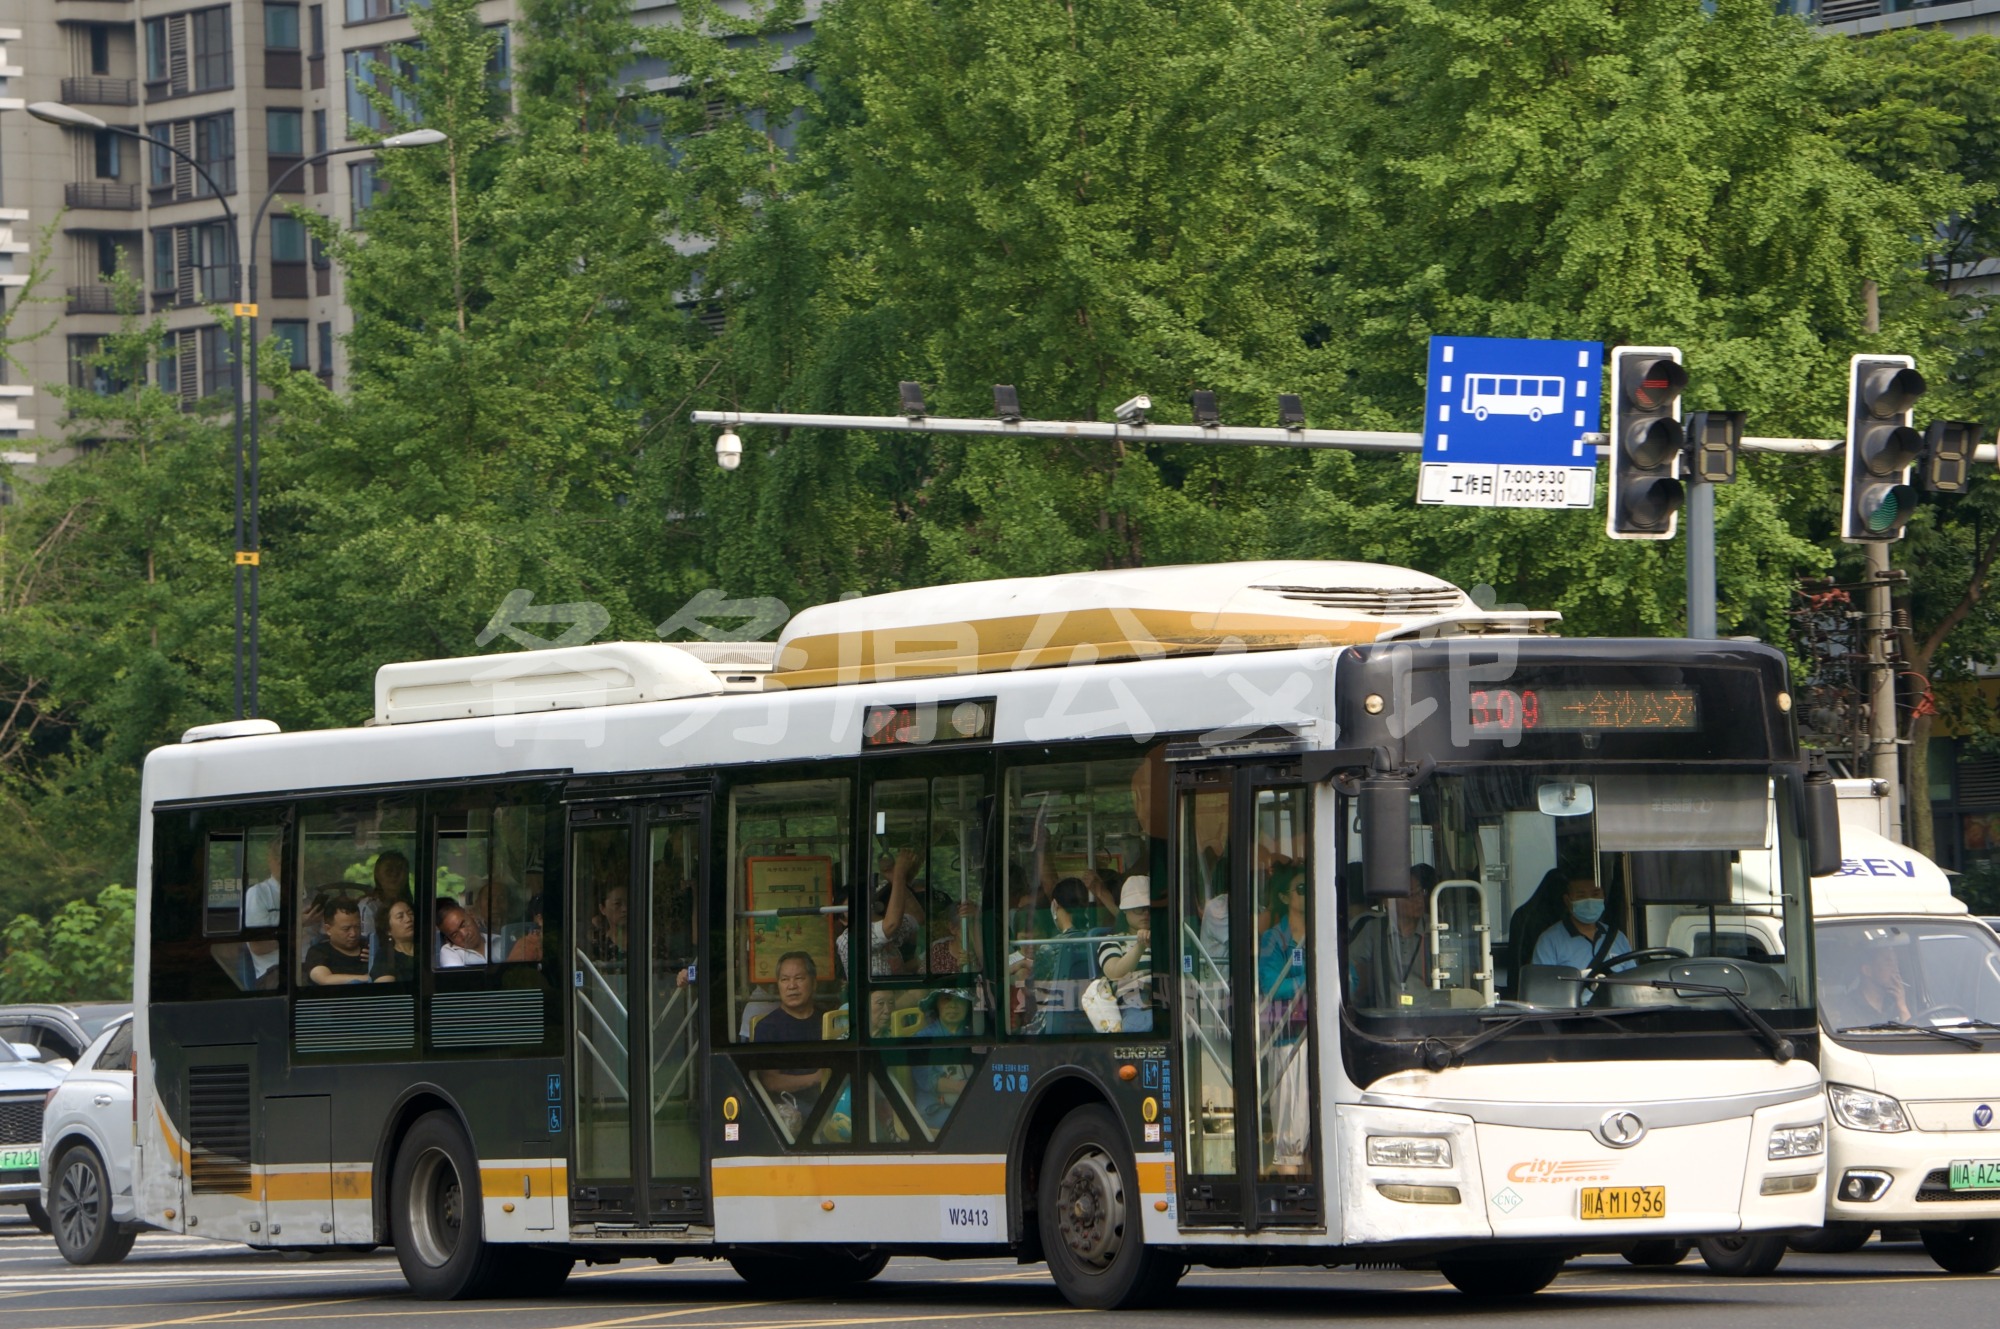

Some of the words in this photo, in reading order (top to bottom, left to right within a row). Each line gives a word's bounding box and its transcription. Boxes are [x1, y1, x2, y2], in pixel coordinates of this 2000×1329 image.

[1449, 474, 1492, 495] 工作日
[1503, 469, 1566, 485] 7:00-9:30
[1501, 488, 1565, 502] 17:00-19:30
[1472, 690, 1537, 728] 309
[1507, 1158, 1559, 1183] City
[1525, 1175, 1610, 1184] Express
[1497, 1195, 1517, 1206] CNG
[949, 1208, 989, 1226] W3413
